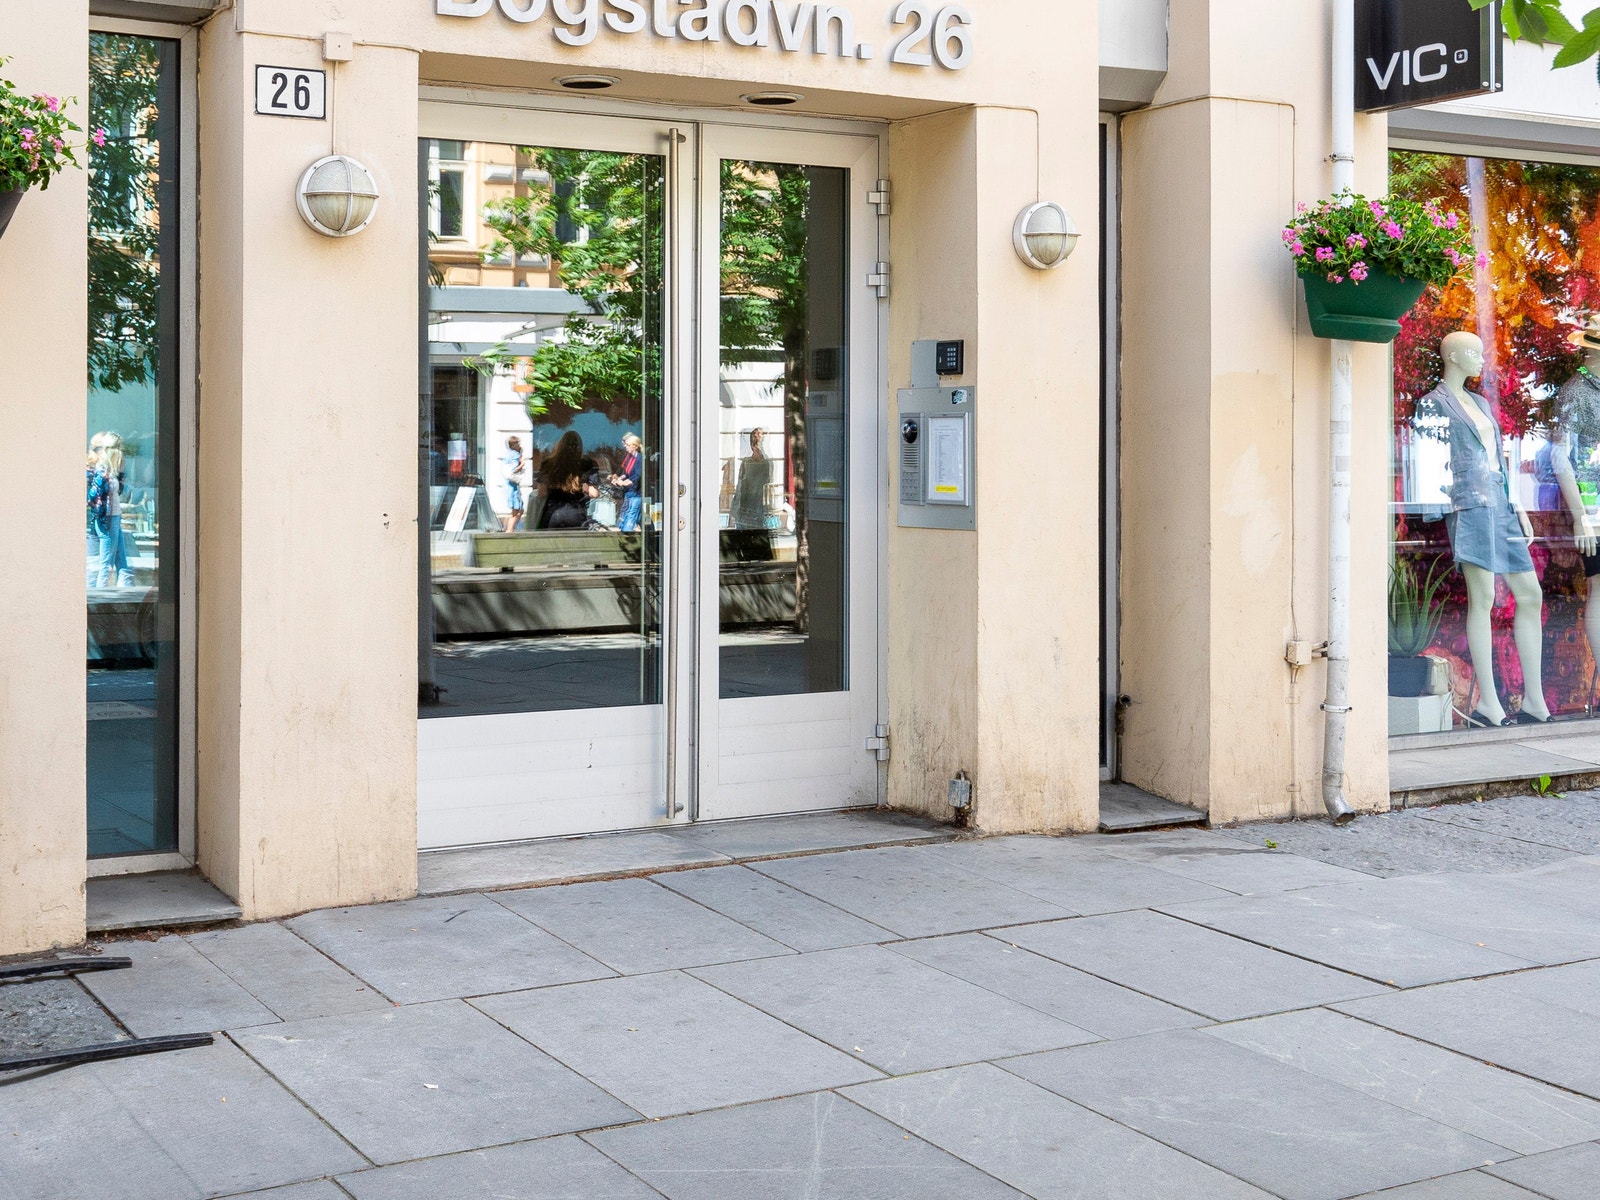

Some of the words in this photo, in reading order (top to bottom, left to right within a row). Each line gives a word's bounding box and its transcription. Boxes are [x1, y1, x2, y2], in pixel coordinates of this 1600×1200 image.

[891, 0, 973, 70] 26
[1366, 43, 1448, 91] VIC
[271, 72, 310, 111] 26
